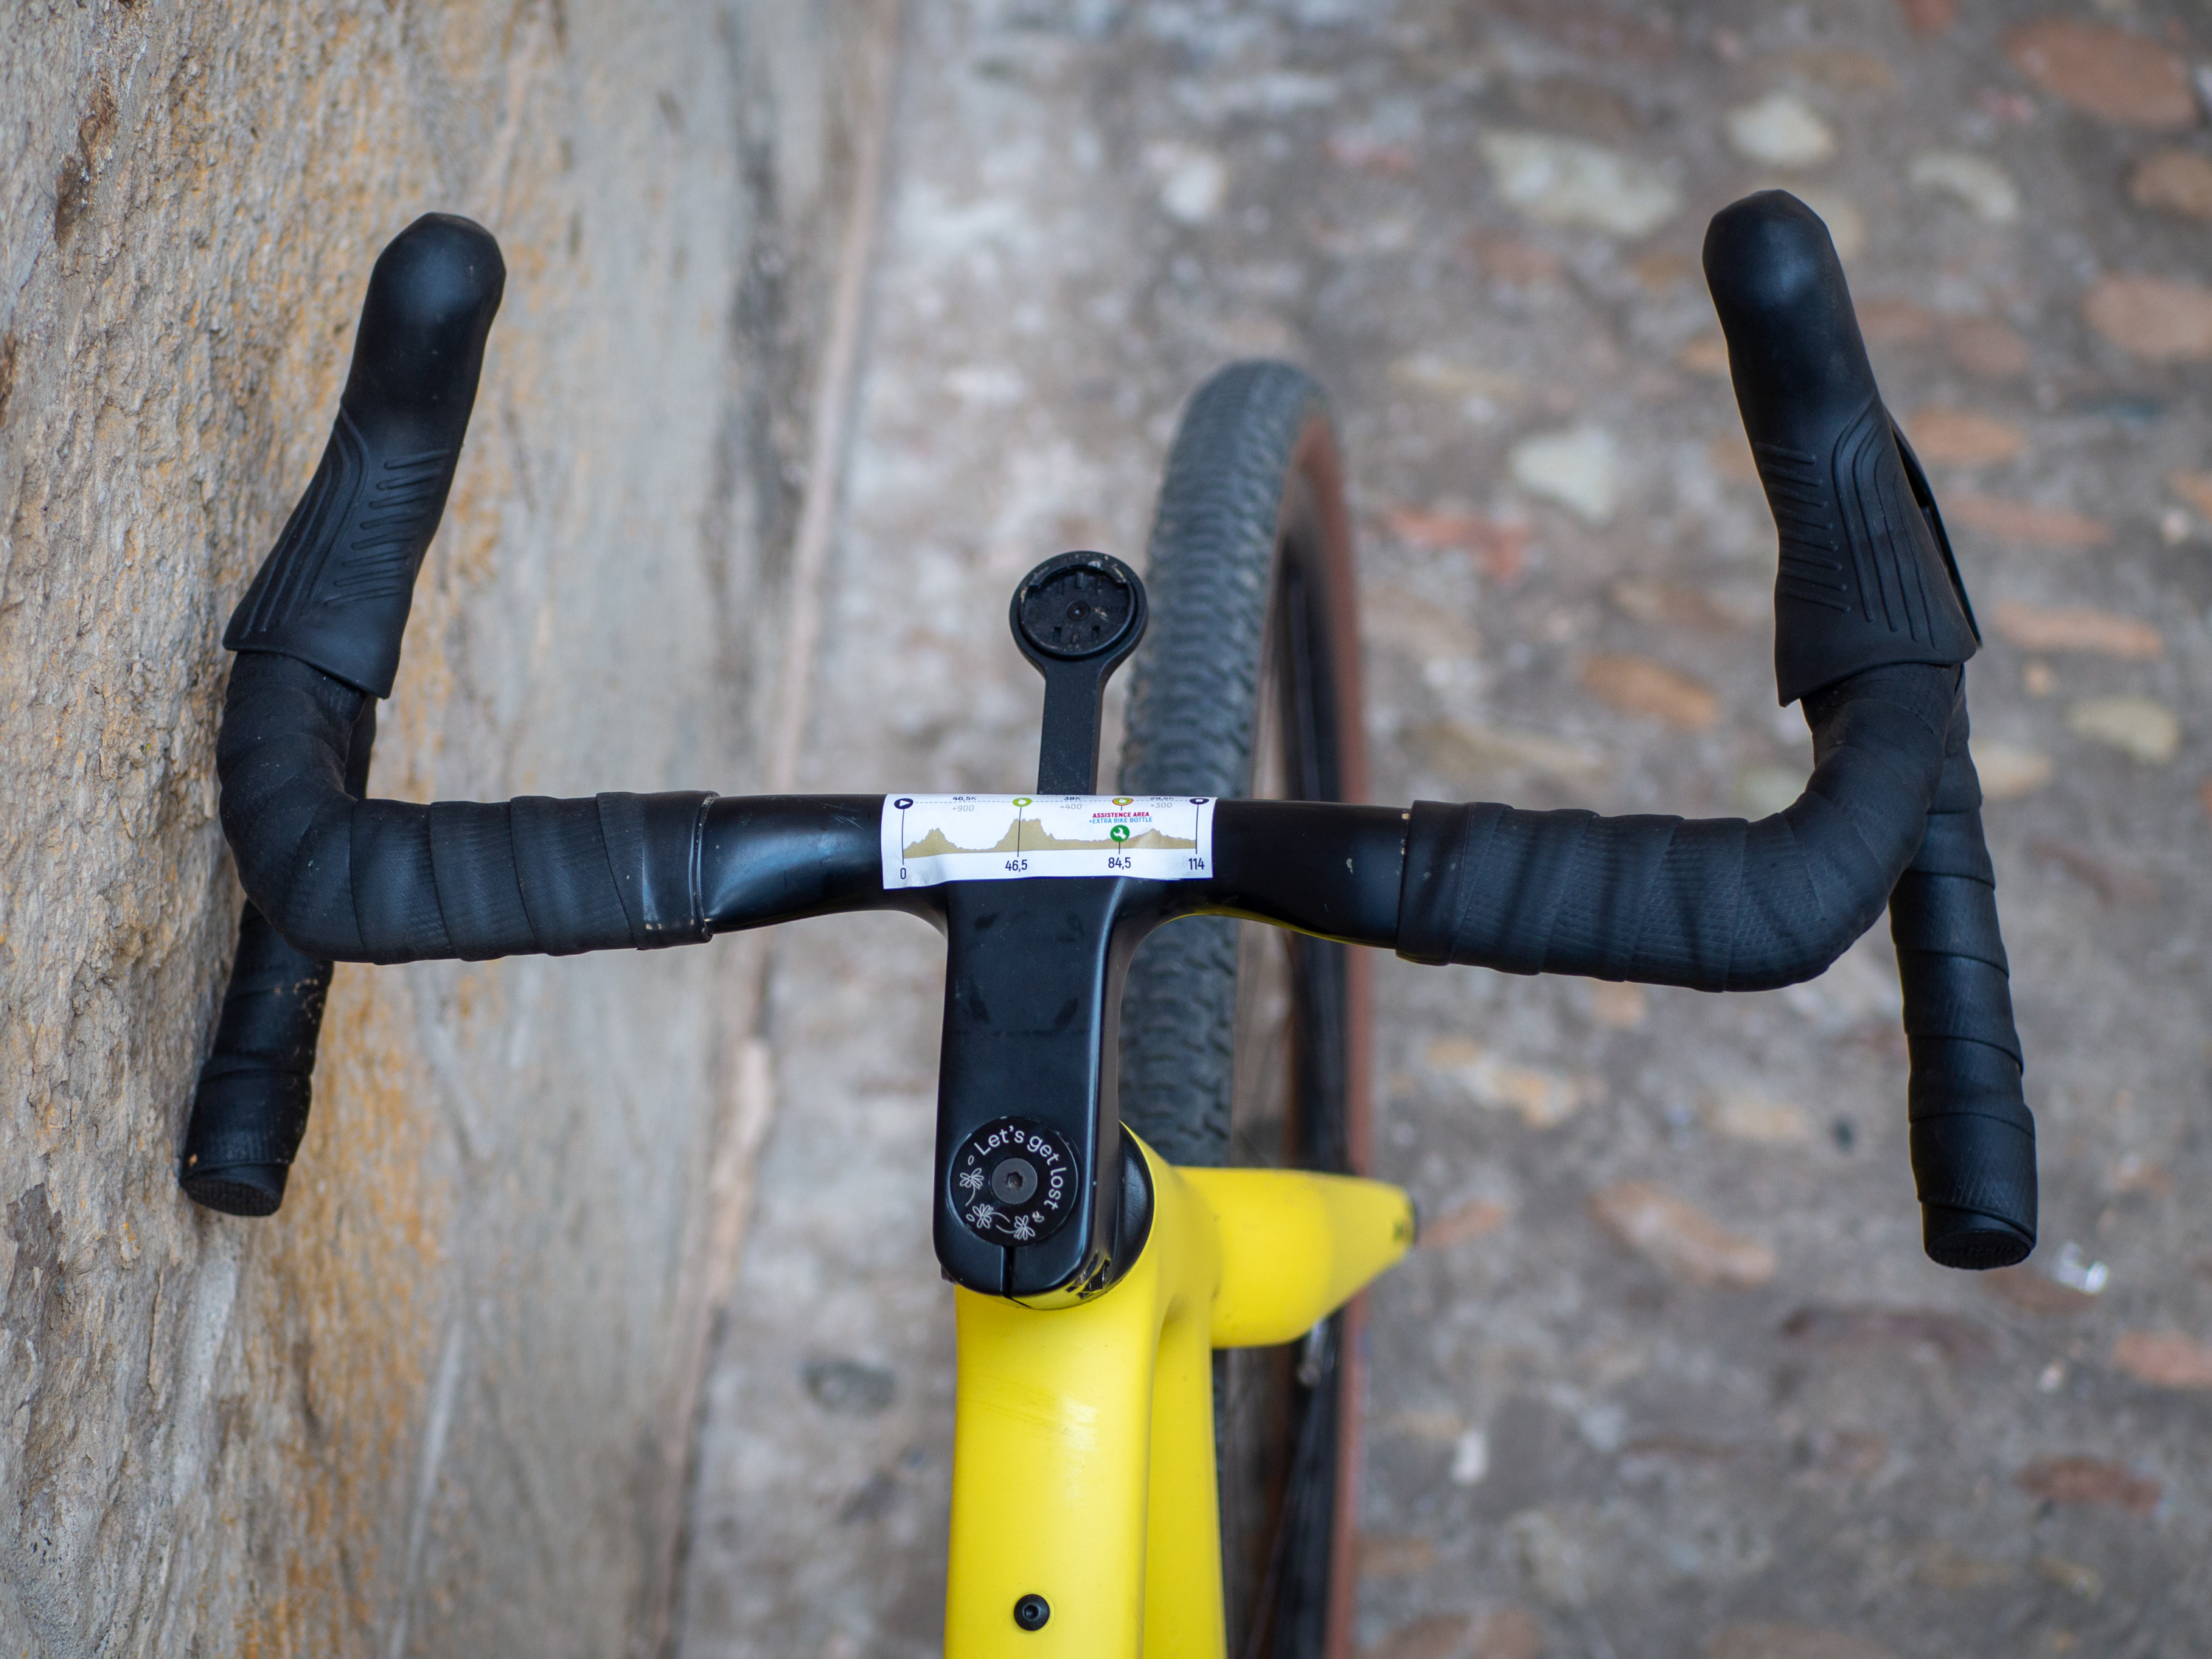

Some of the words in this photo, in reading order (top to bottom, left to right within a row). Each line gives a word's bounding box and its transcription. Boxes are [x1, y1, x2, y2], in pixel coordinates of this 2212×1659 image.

[1004, 859, 1028, 872] 46,5
[1107, 857, 1131, 870] 84,5
[1188, 858, 1205, 870] 114
[900, 867, 907, 880] 0
[1026, 1135, 1060, 1165] get
[1043, 1167, 1067, 1211] lost
